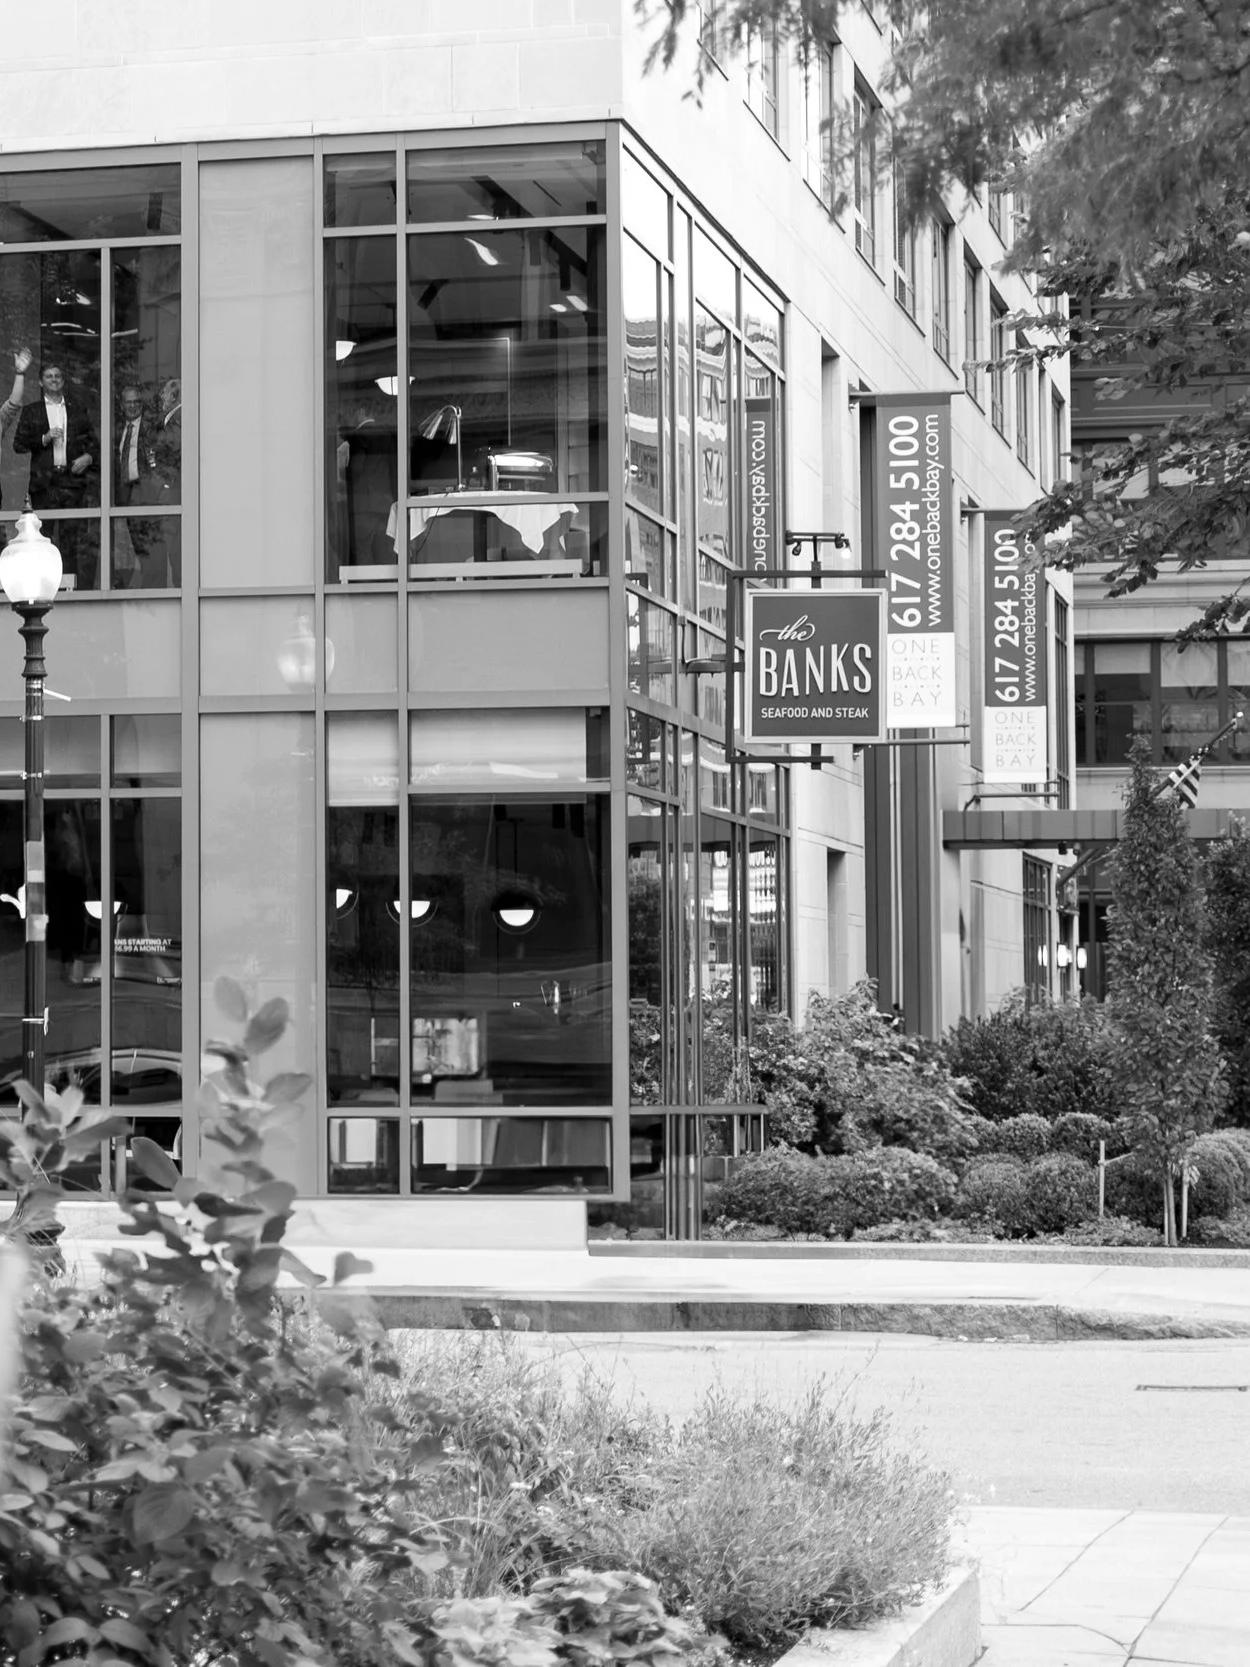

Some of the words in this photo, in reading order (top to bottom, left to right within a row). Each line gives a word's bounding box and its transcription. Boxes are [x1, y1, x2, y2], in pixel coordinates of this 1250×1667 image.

[888, 415, 920, 490] 5100
[890, 501, 921, 560] 284
[921, 414, 944, 627] www.onebackbay.com
[891, 572, 922, 628] 617
[759, 614, 815, 641] the
[994, 598, 1020, 648] 284
[892, 638, 941, 655] ONE
[759, 643, 872, 698] BANKS
[893, 665, 942, 681] BACK
[994, 656, 1020, 702] 617
[893, 691, 942, 707] BAY
[761, 707, 809, 719] SEAFOOD
[810, 707, 833, 719] AND
[835, 707, 869, 719] STEAK
[994, 710, 1036, 725] ONE
[995, 732, 1037, 746] BACK
[995, 754, 1036, 767] BAY
